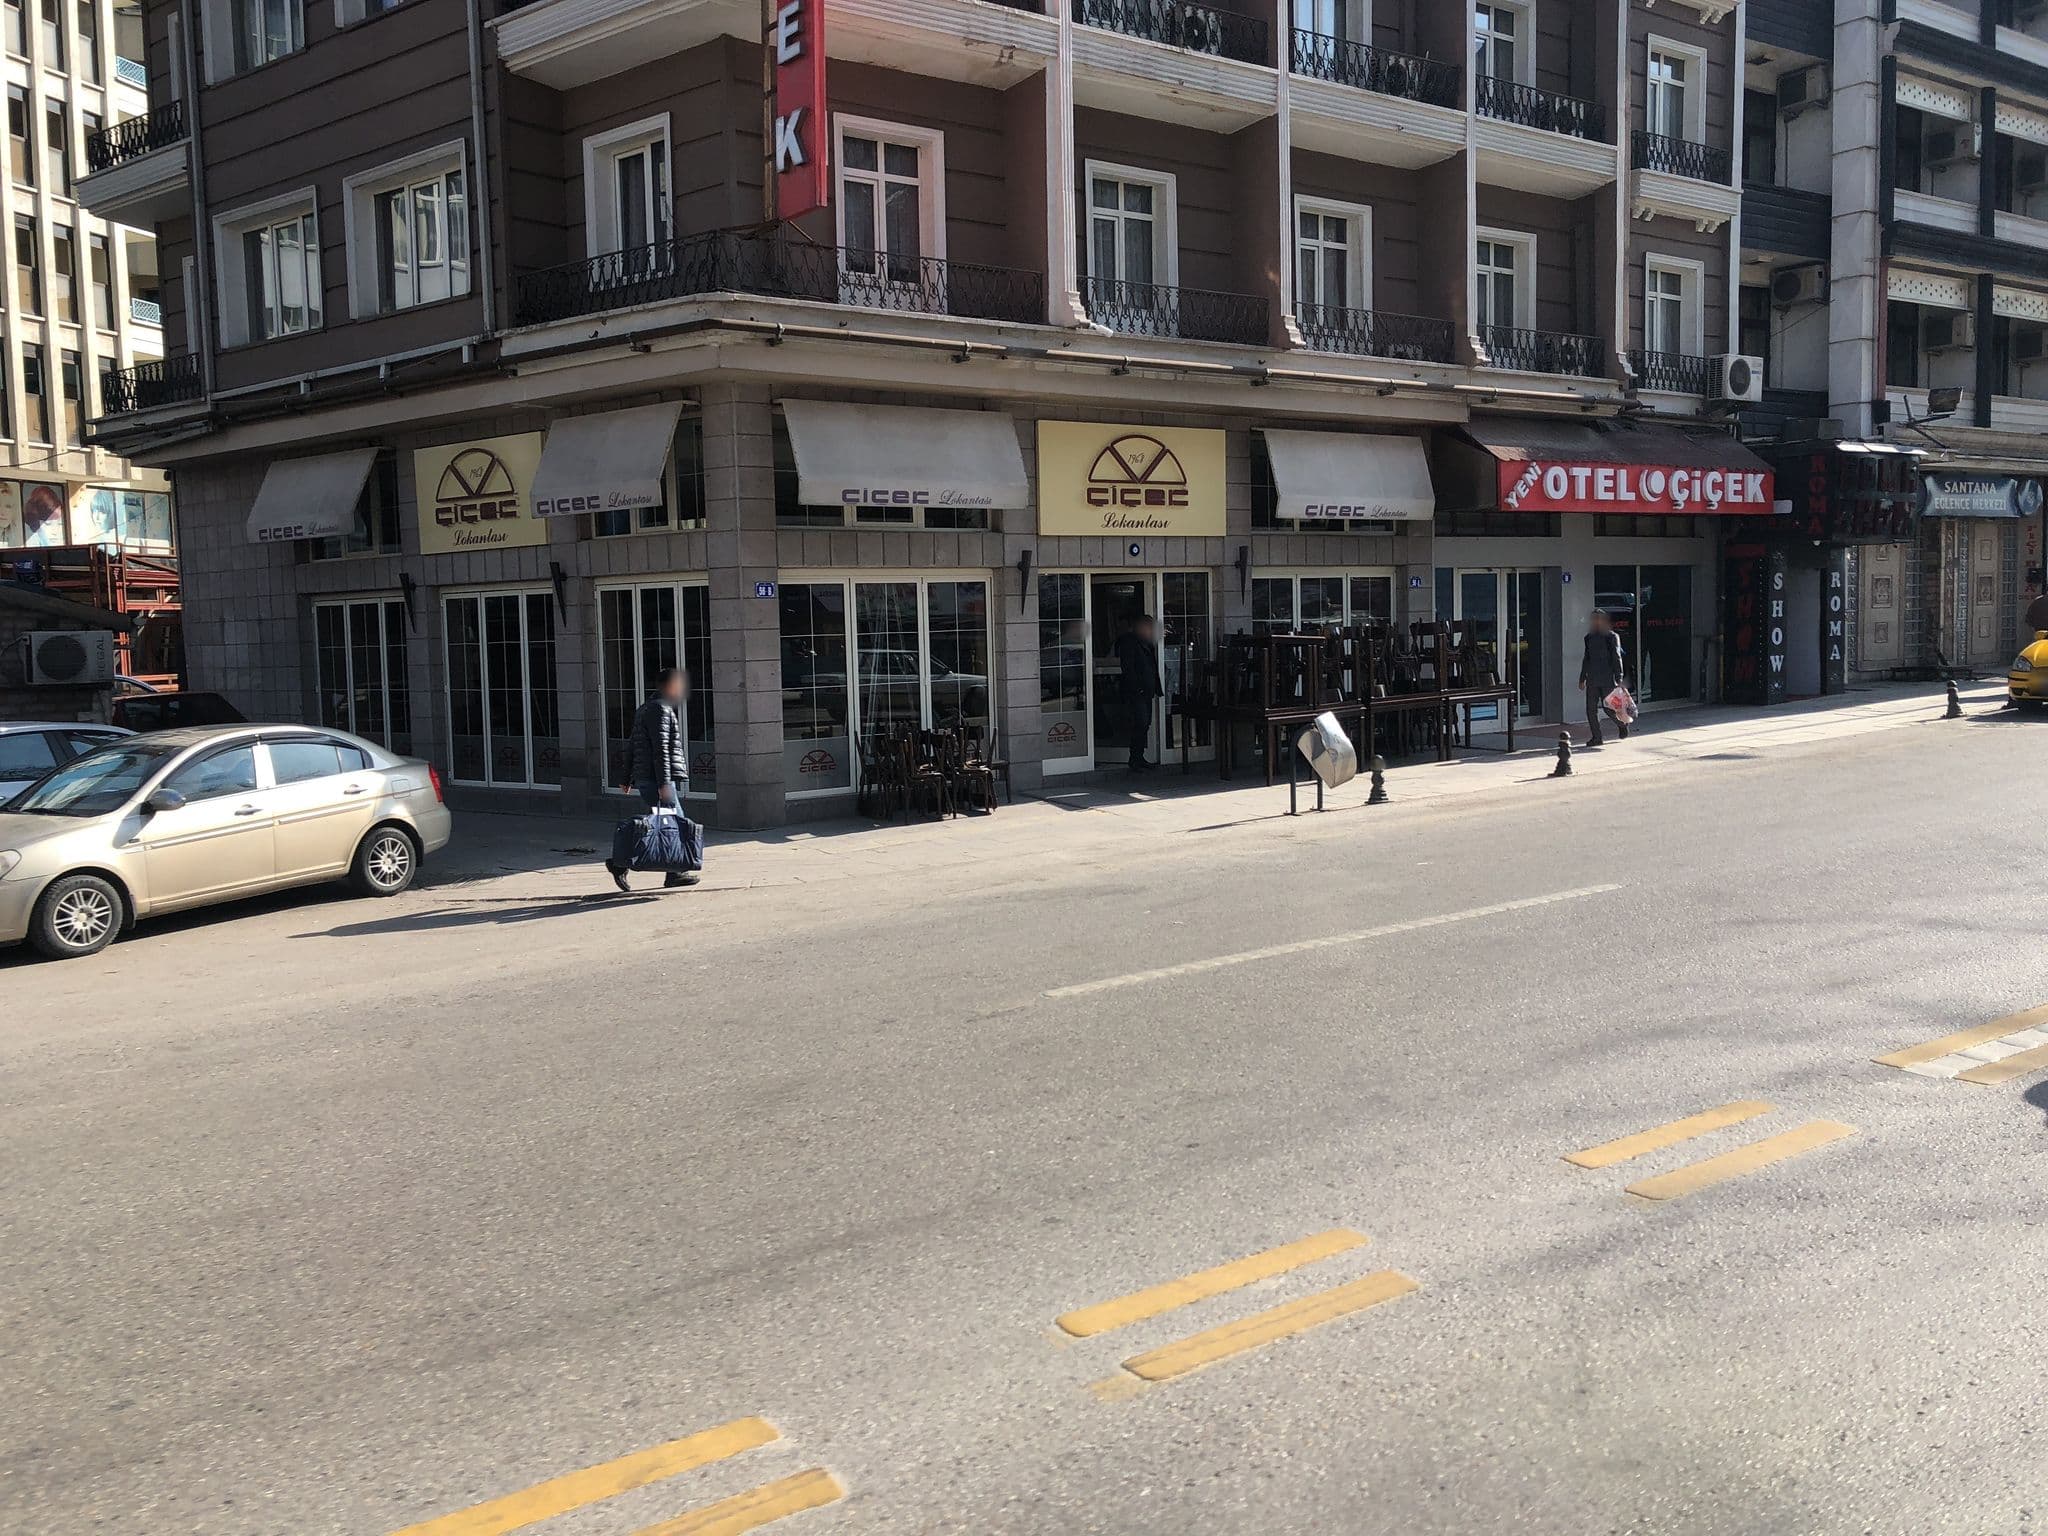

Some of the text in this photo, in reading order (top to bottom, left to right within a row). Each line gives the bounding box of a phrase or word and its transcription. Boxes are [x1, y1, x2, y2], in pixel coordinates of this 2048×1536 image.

[1543, 466, 1635, 500] OTEL
[1944, 481, 1997, 494] SANTANA
[1770, 572, 1785, 673] SHOW
[1829, 571, 1842, 661] ROMA
